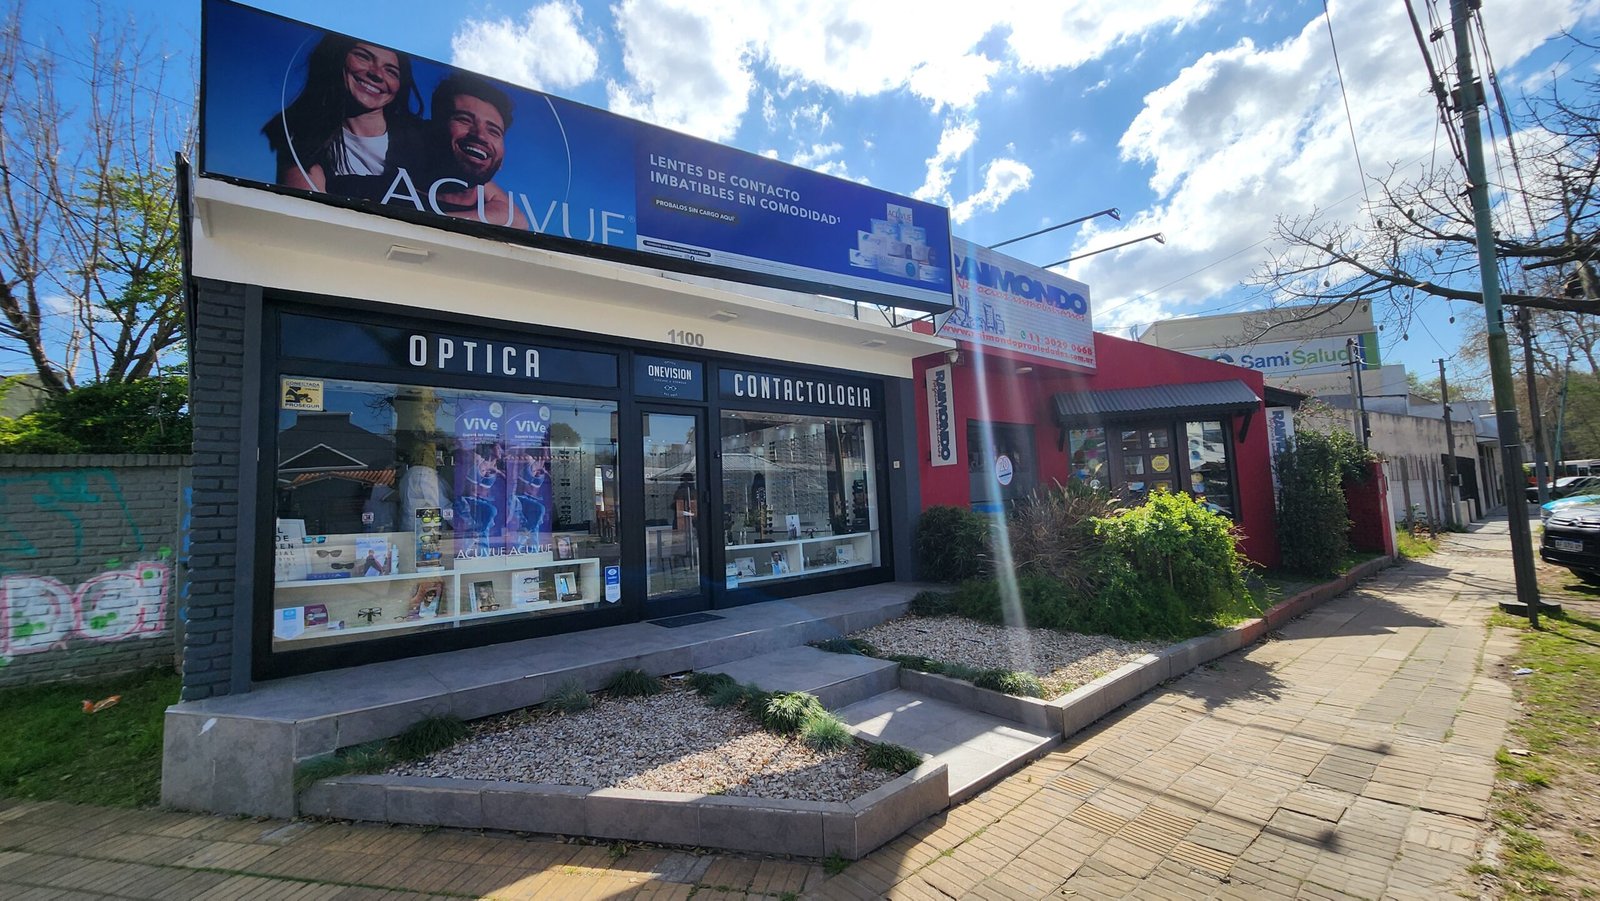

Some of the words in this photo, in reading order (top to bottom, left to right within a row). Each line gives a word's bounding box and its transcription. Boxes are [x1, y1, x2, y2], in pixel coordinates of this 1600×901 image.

[650, 154, 703, 177] LENTES
[708, 168, 726, 184] DE
[730, 175, 801, 202] CONTACTO
[650, 170, 735, 201] IMBATIBLES
[739, 192, 756, 207] EN
[656, 199, 688, 212] PROBALOS
[699, 209, 720, 219] CARGO
[667, 329, 705, 347] 1100
[942, 325, 1094, 365] www.imondopropiedades.com.ar
[1028, 332, 1041, 343] 11
[409, 335, 540, 378] OPTICA
[648, 364, 692, 381] ONEVISION
[734, 373, 871, 408] CONTACTOLOGIA
[463, 418, 498, 431] ViVe
[936, 370, 951, 461] RAIMONDO
[515, 420, 546, 433] ViVe
[456, 547, 506, 560] ACUVUE
[509, 543, 552, 556] ACUVUE
